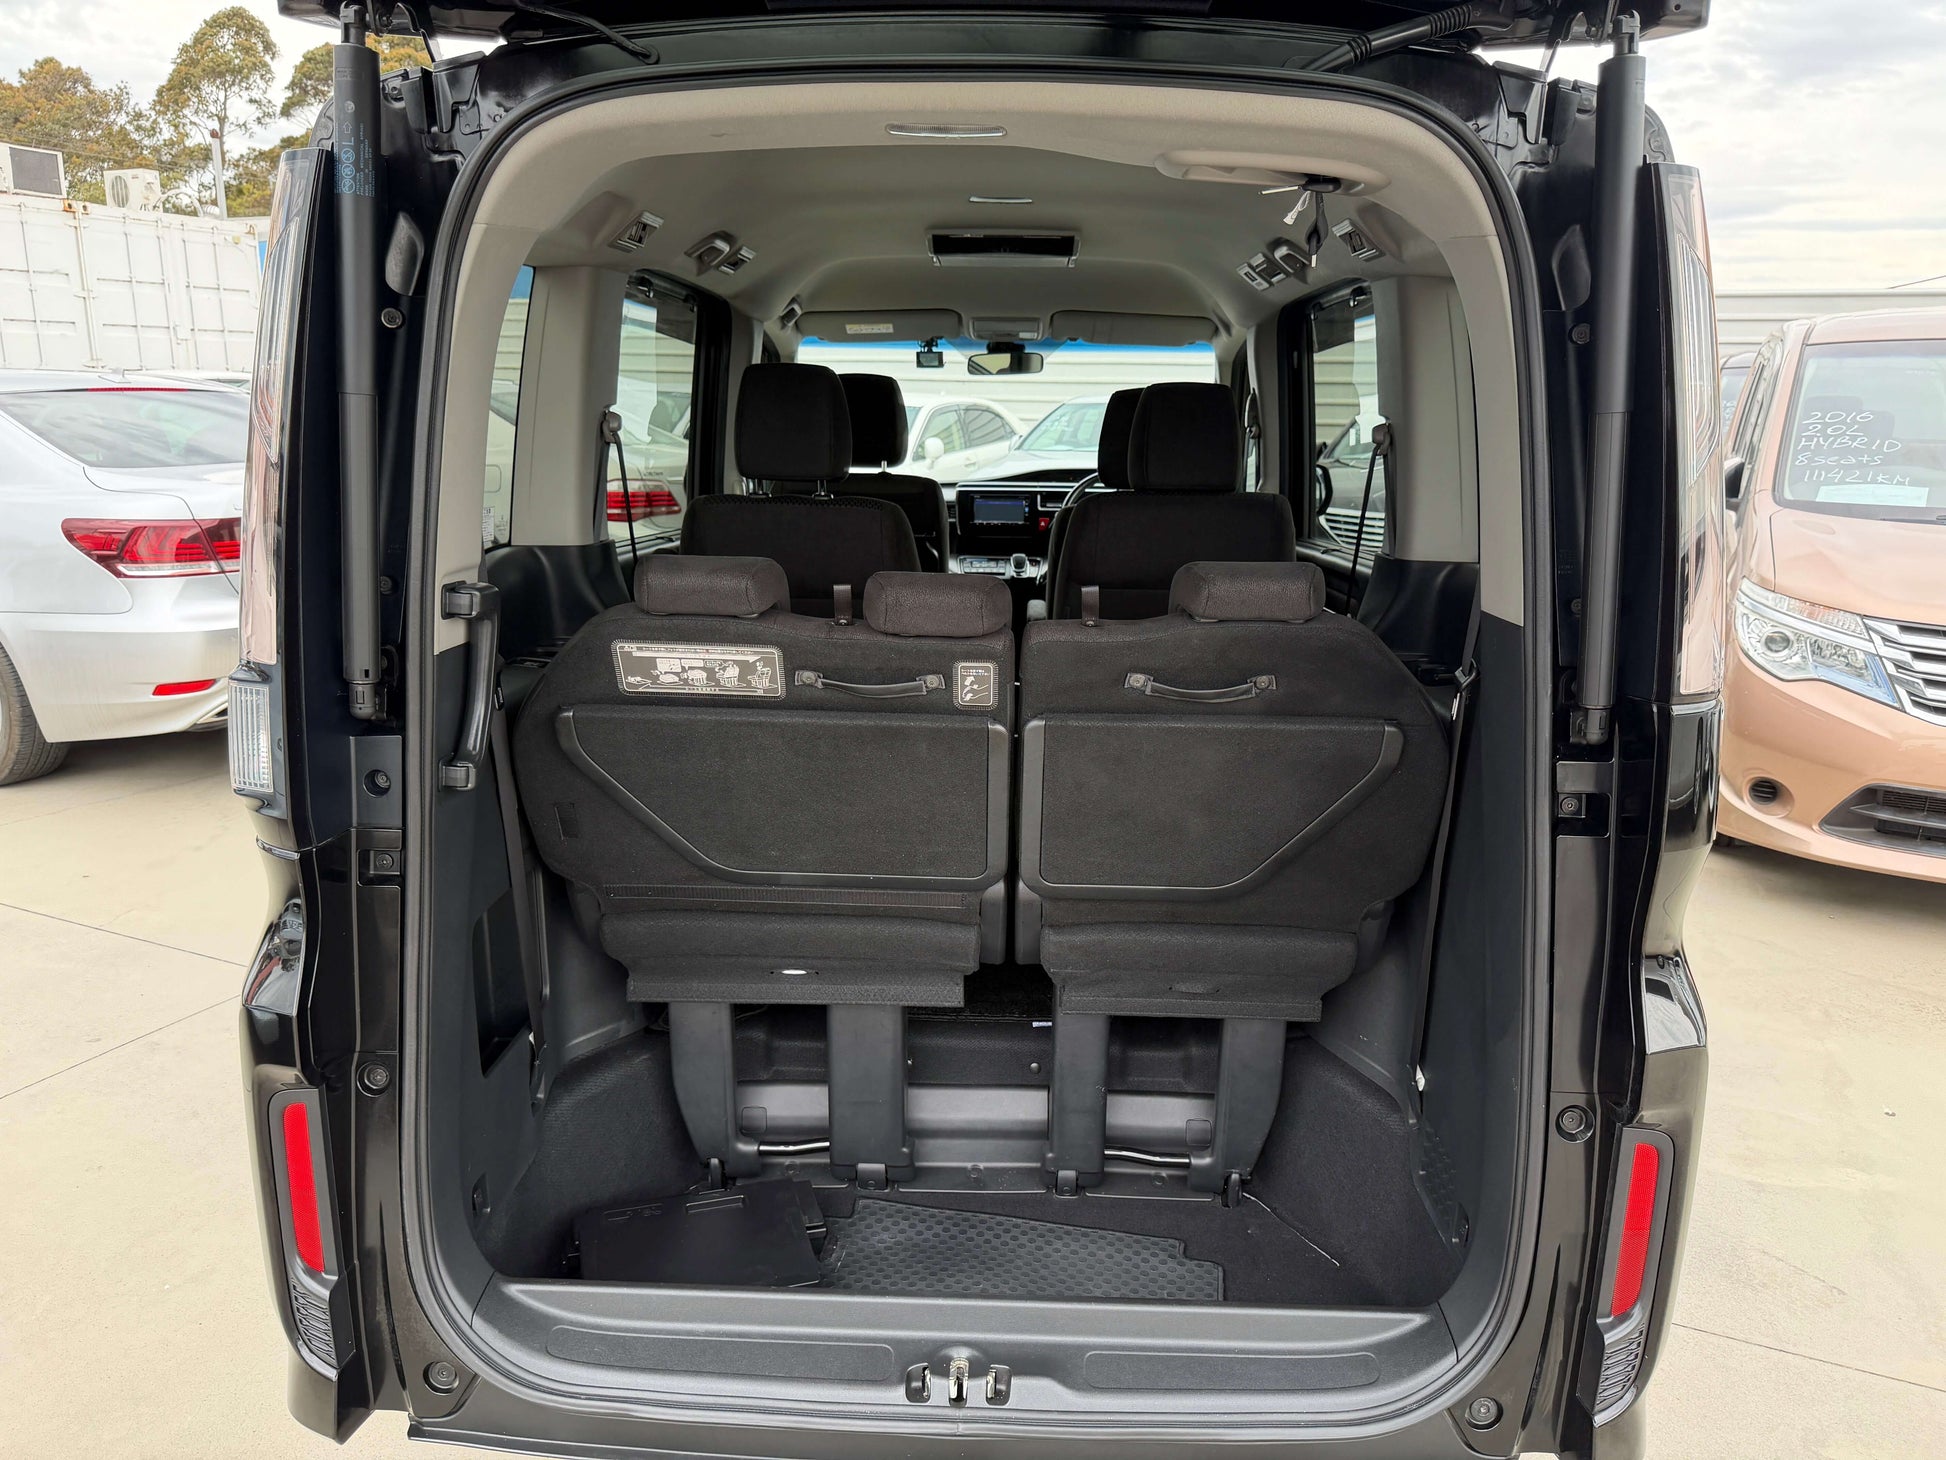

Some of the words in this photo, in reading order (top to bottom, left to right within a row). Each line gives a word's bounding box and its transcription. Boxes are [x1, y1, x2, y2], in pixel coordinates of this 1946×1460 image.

[1802, 411, 1874, 424] 2016
[1801, 424, 1864, 436] 2.0L
[1797, 435, 1902, 453] HYBRID
